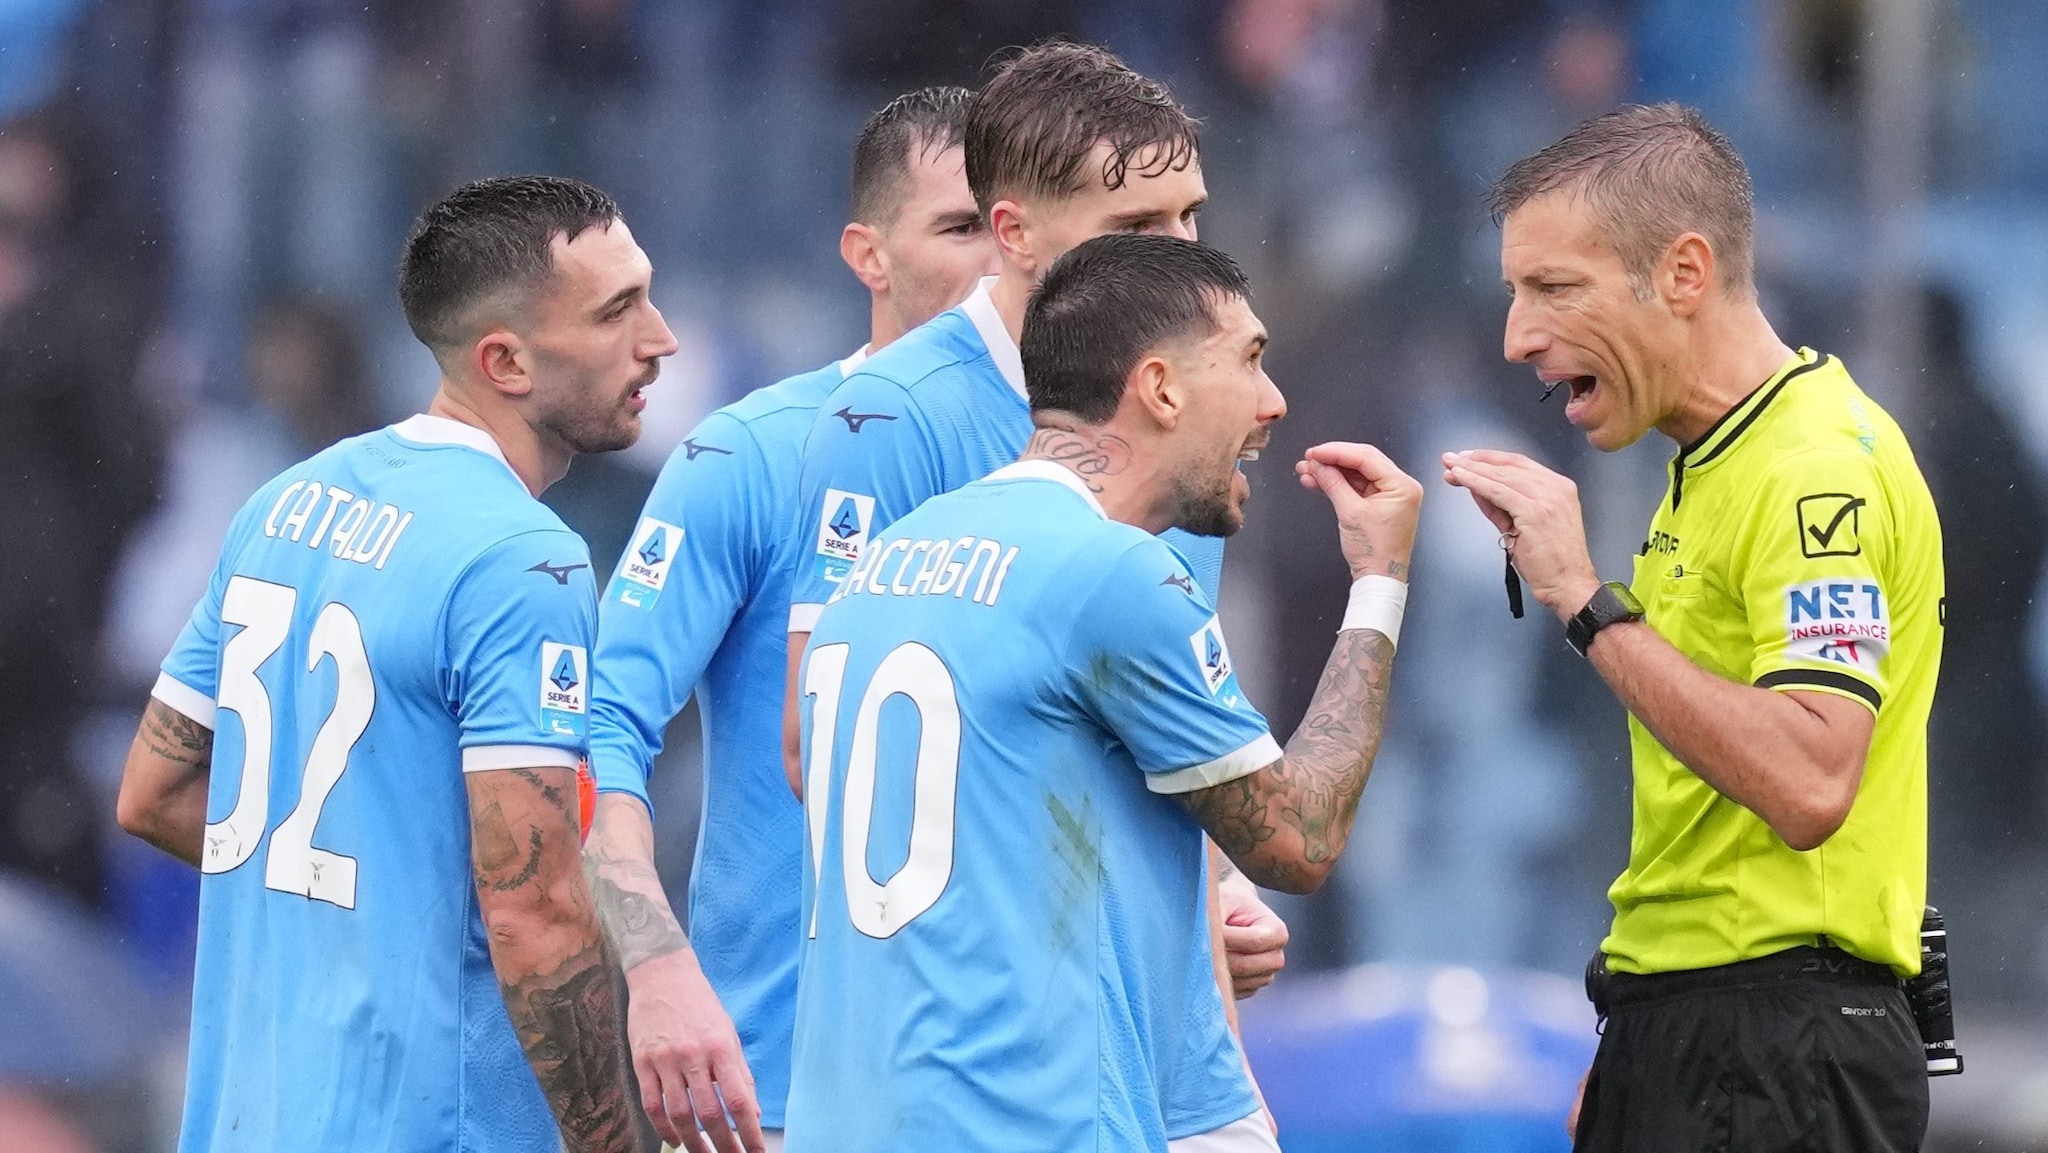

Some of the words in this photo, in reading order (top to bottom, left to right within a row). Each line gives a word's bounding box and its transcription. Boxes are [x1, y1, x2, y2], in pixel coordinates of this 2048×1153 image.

[264, 479, 415, 571] CATALDI
[824, 538, 851, 552] SERIE
[852, 544, 859, 554] A
[630, 564, 653, 577] SERIE
[653, 571, 660, 581] A
[1790, 584, 1881, 624] NET
[1791, 623, 1887, 641] INSURANCE
[548, 692, 571, 704] SERIE
[573, 695, 579, 705] A
[201, 574, 377, 911] 32
[803, 640, 962, 940] 10
